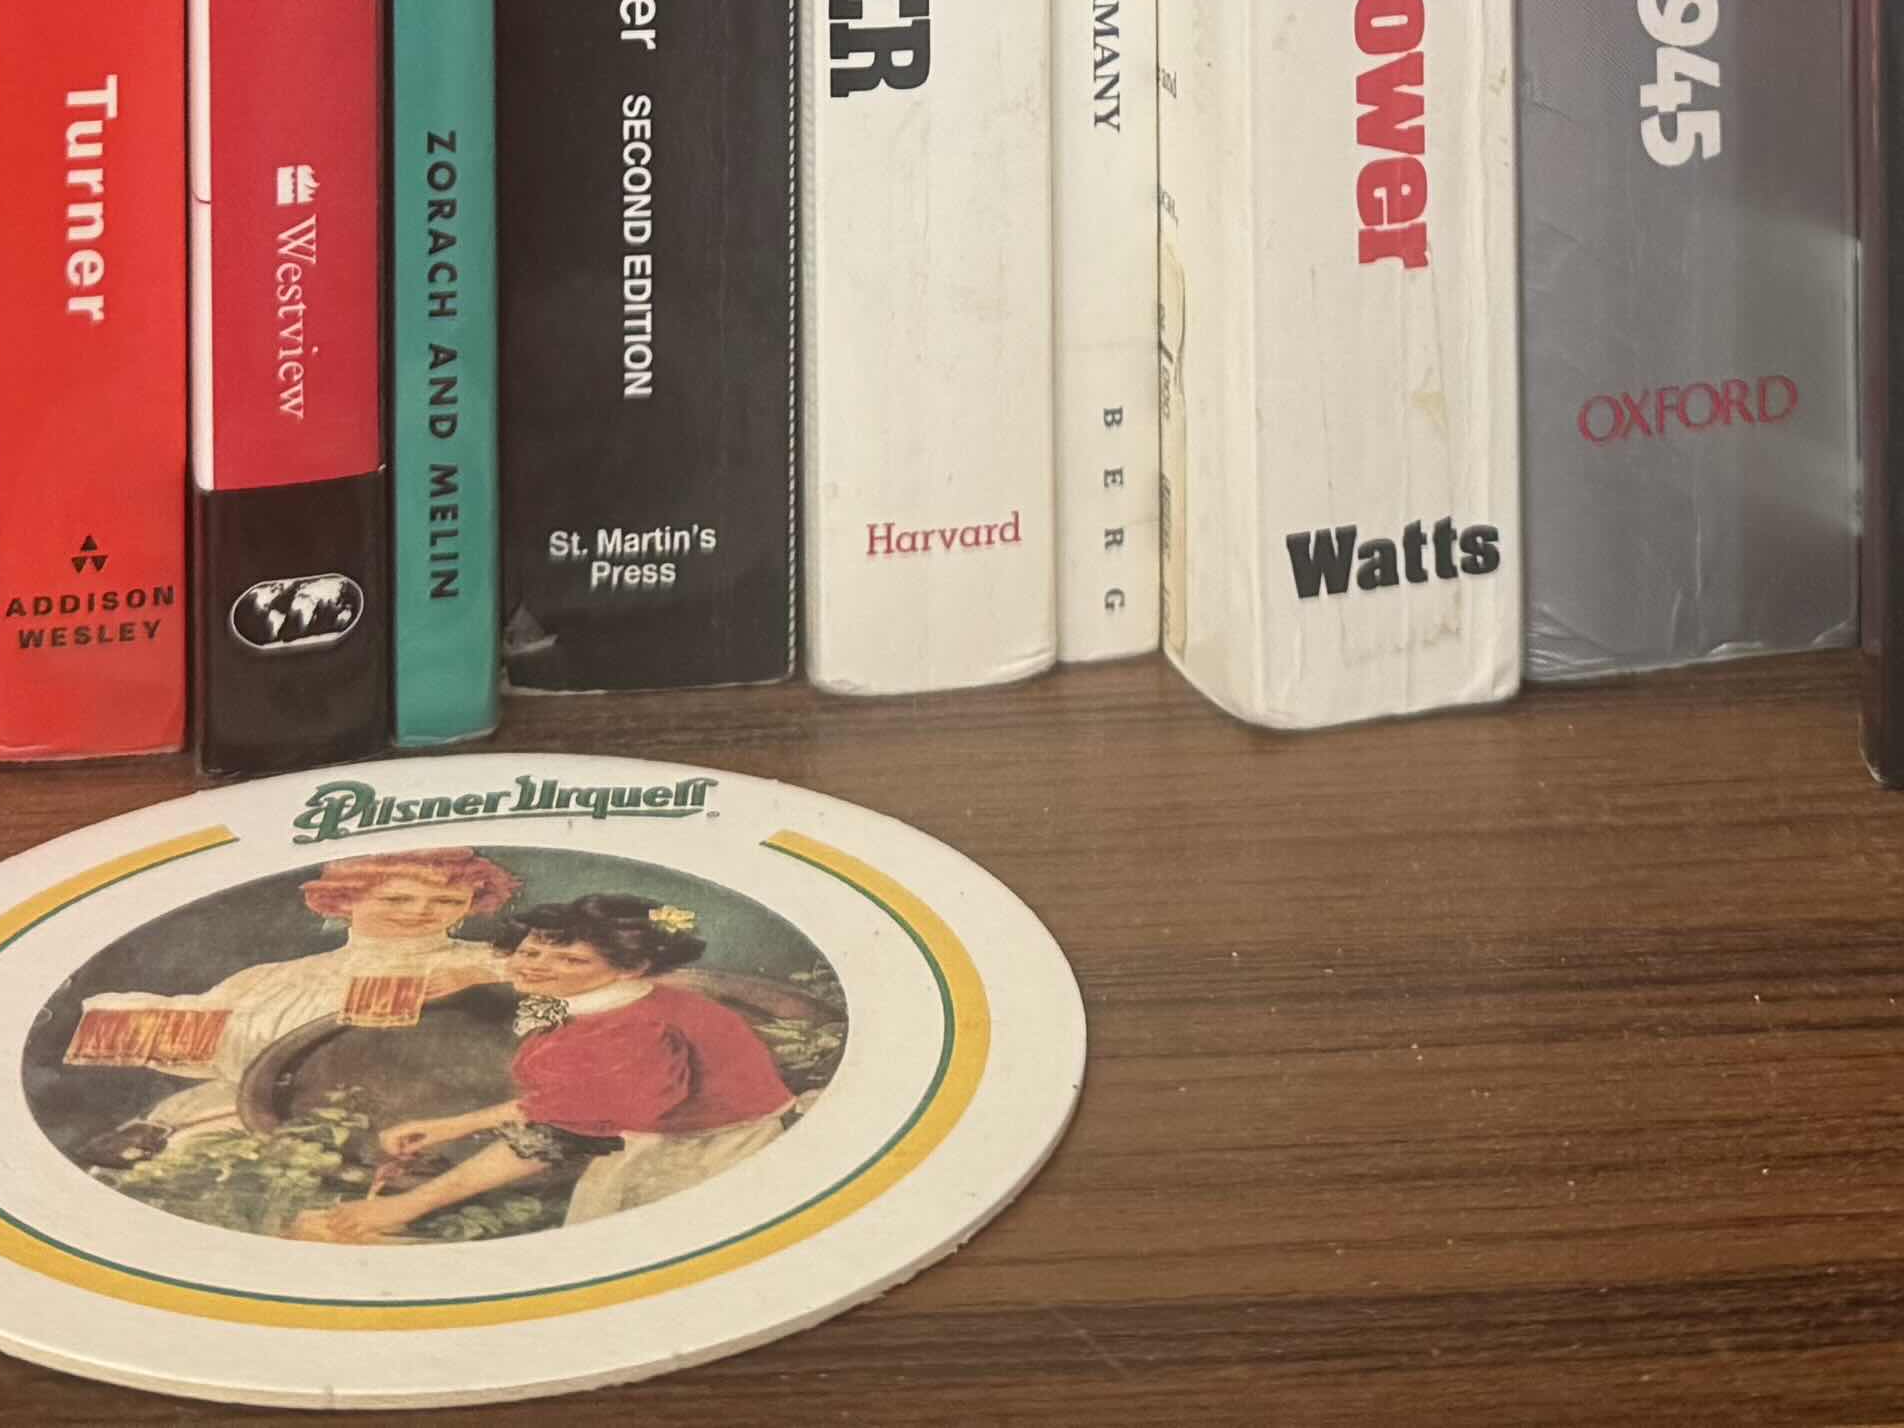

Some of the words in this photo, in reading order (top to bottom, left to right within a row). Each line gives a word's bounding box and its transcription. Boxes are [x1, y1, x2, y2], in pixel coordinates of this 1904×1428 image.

[63, 74, 119, 324] Turner
[425, 130, 458, 322] ZORACH
[276, 214, 319, 421] Westview
[428, 343, 460, 442] AND
[1576, 374, 1799, 446] OXFORD
[428, 463, 460, 600] MELIN
[548, 529, 591, 559] St.
[596, 523, 718, 554] Martin's
[865, 510, 1022, 556] Harvard
[1284, 515, 1502, 600] Watts
[3, 584, 177, 621] ADDISON
[589, 558, 677, 592] Press
[16, 619, 163, 652] WESLEY
[292, 779, 511, 844] Pilsner
